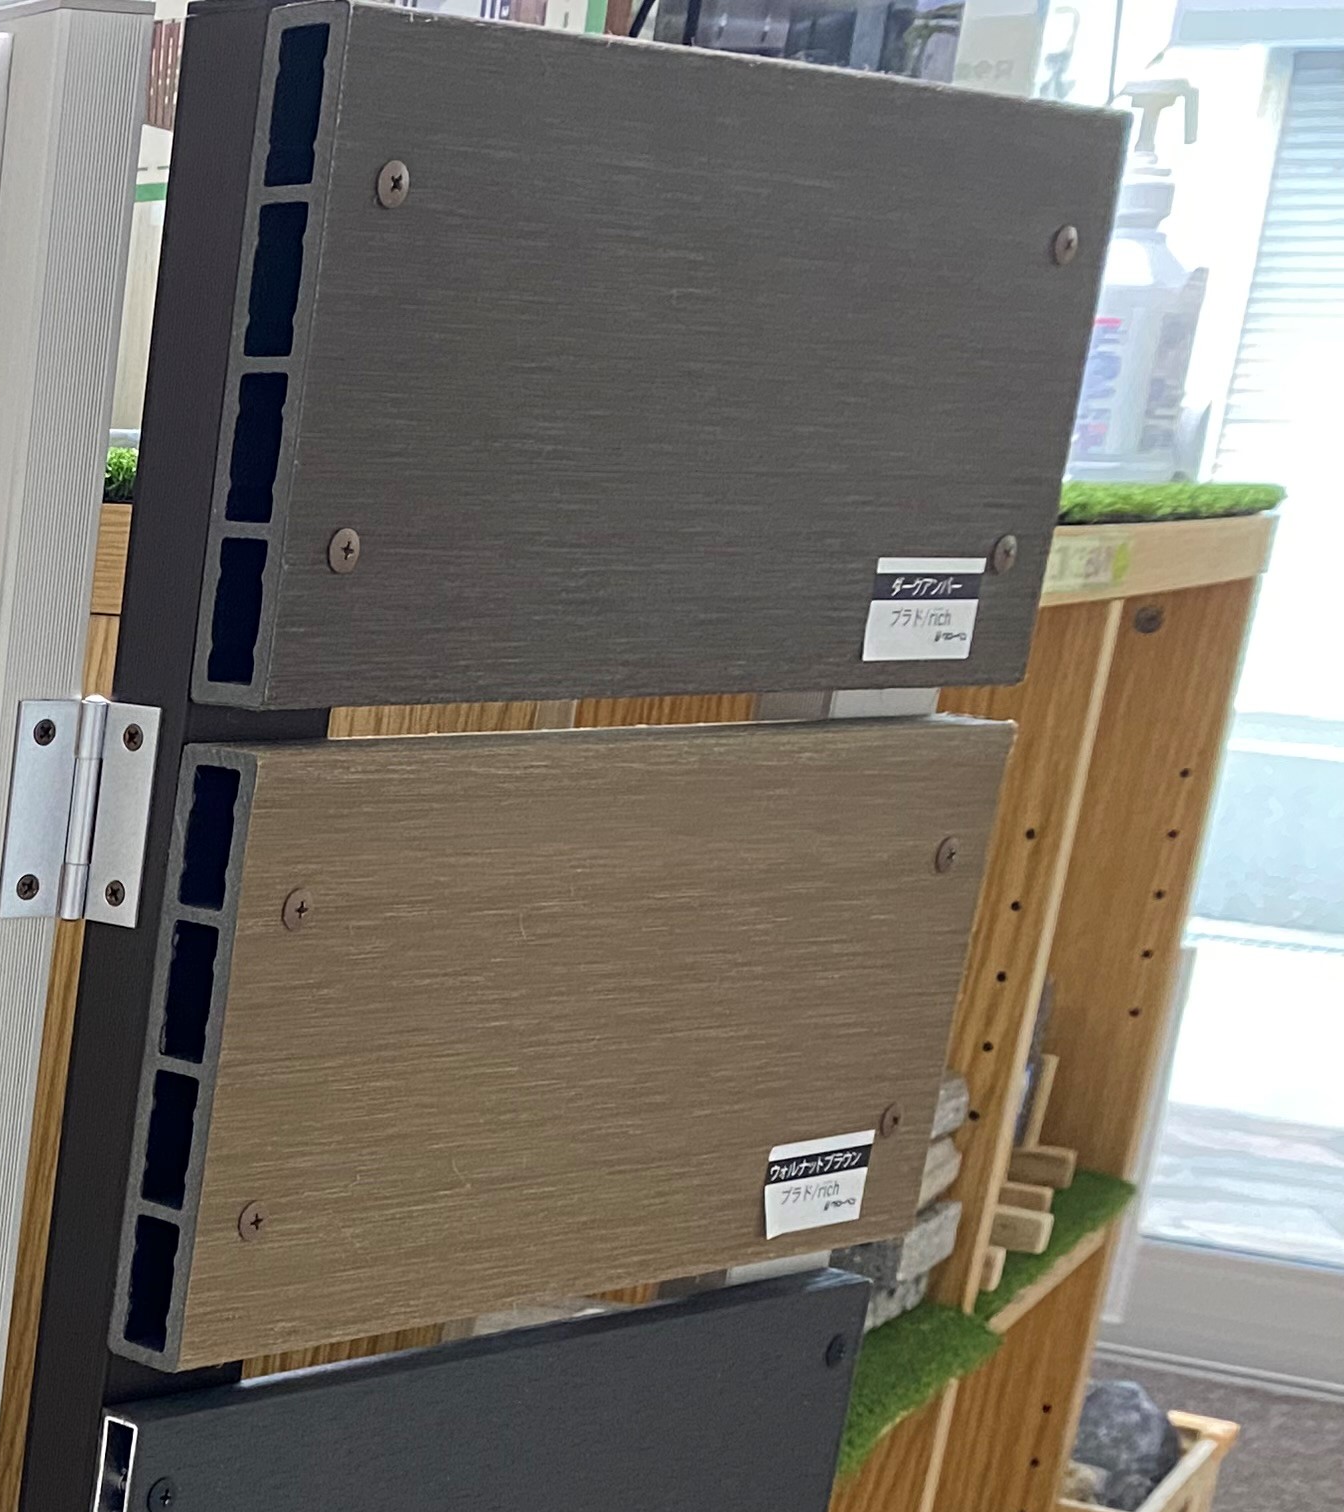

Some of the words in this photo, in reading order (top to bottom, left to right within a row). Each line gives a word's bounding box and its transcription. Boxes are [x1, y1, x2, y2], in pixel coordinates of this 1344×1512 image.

[769, 1152, 863, 1182] ウォルナットブラウン
